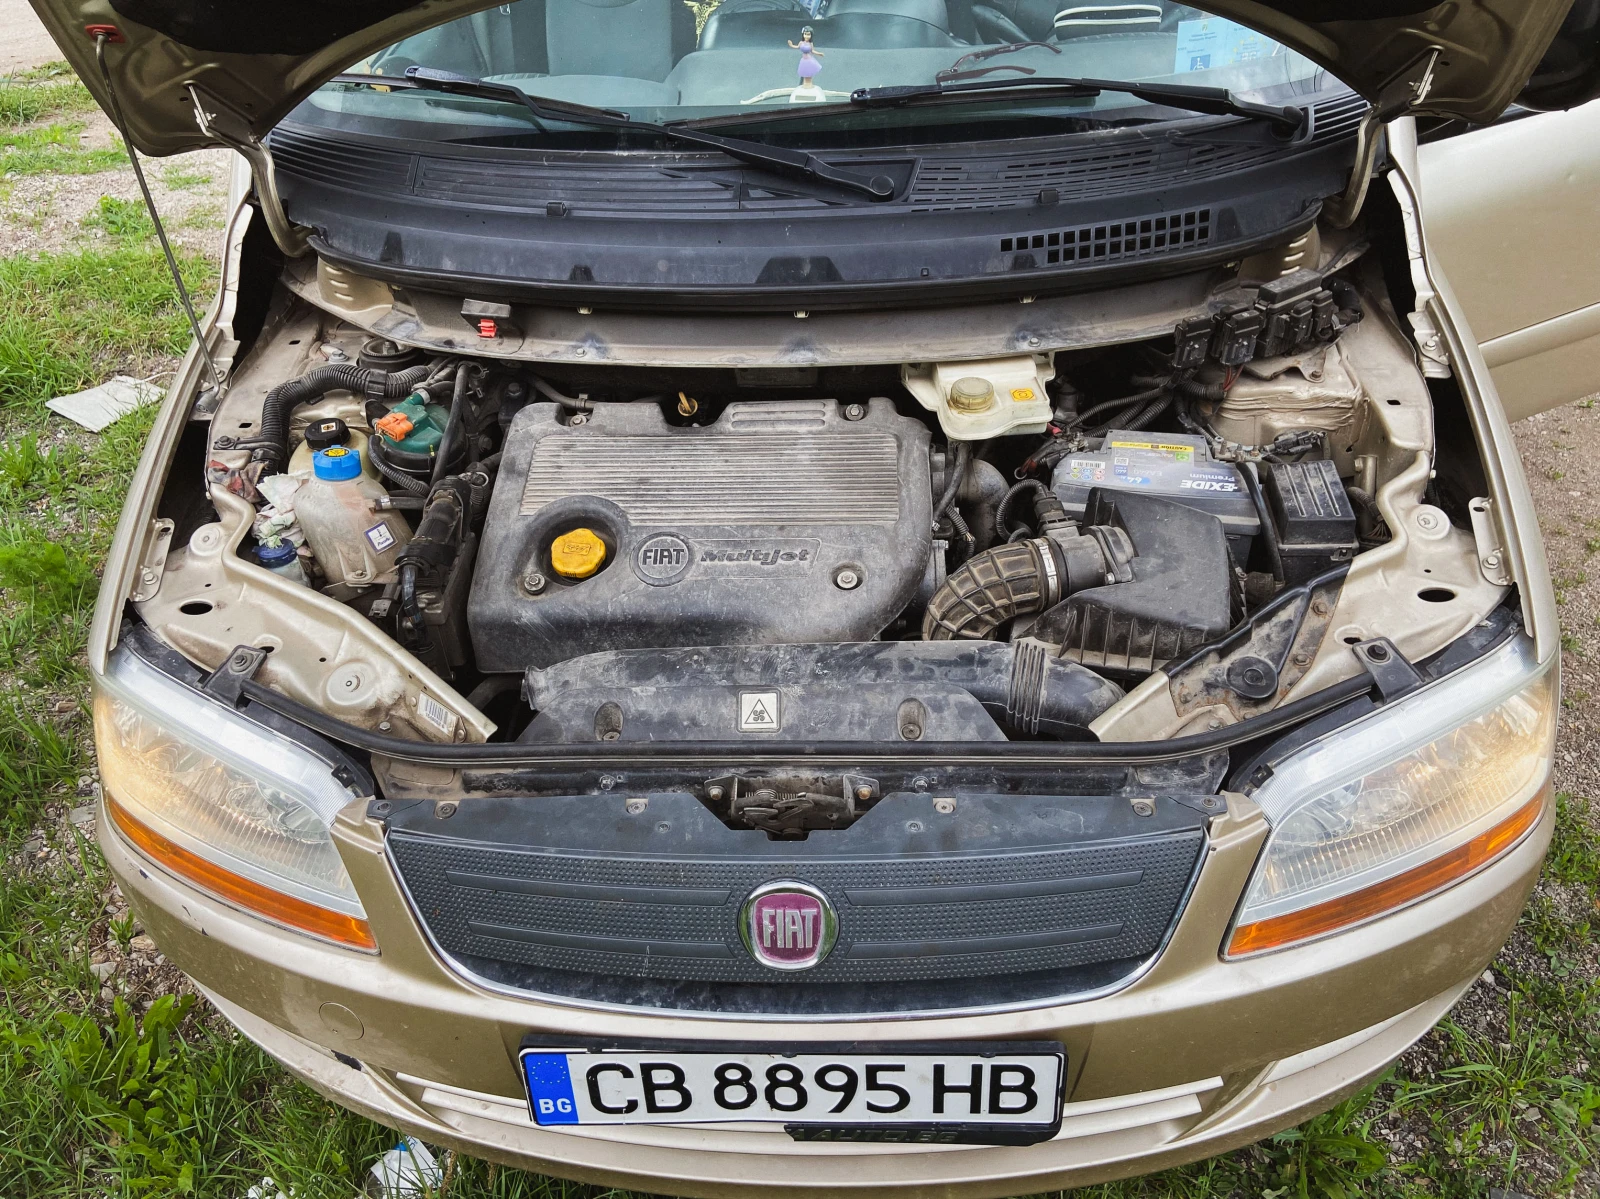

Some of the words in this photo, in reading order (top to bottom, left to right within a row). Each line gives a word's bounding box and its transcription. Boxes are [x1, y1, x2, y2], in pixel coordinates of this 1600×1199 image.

[1179, 479, 1238, 491] EXIDE
[1189, 473, 1235, 482] Premium
[642, 547, 685, 566] FIAT
[762, 907, 817, 949] FIAT
[585, 1062, 693, 1115] CB
[712, 1062, 911, 1115] 8895
[932, 1063, 1039, 1115] HB
[539, 1098, 573, 1115] BG
